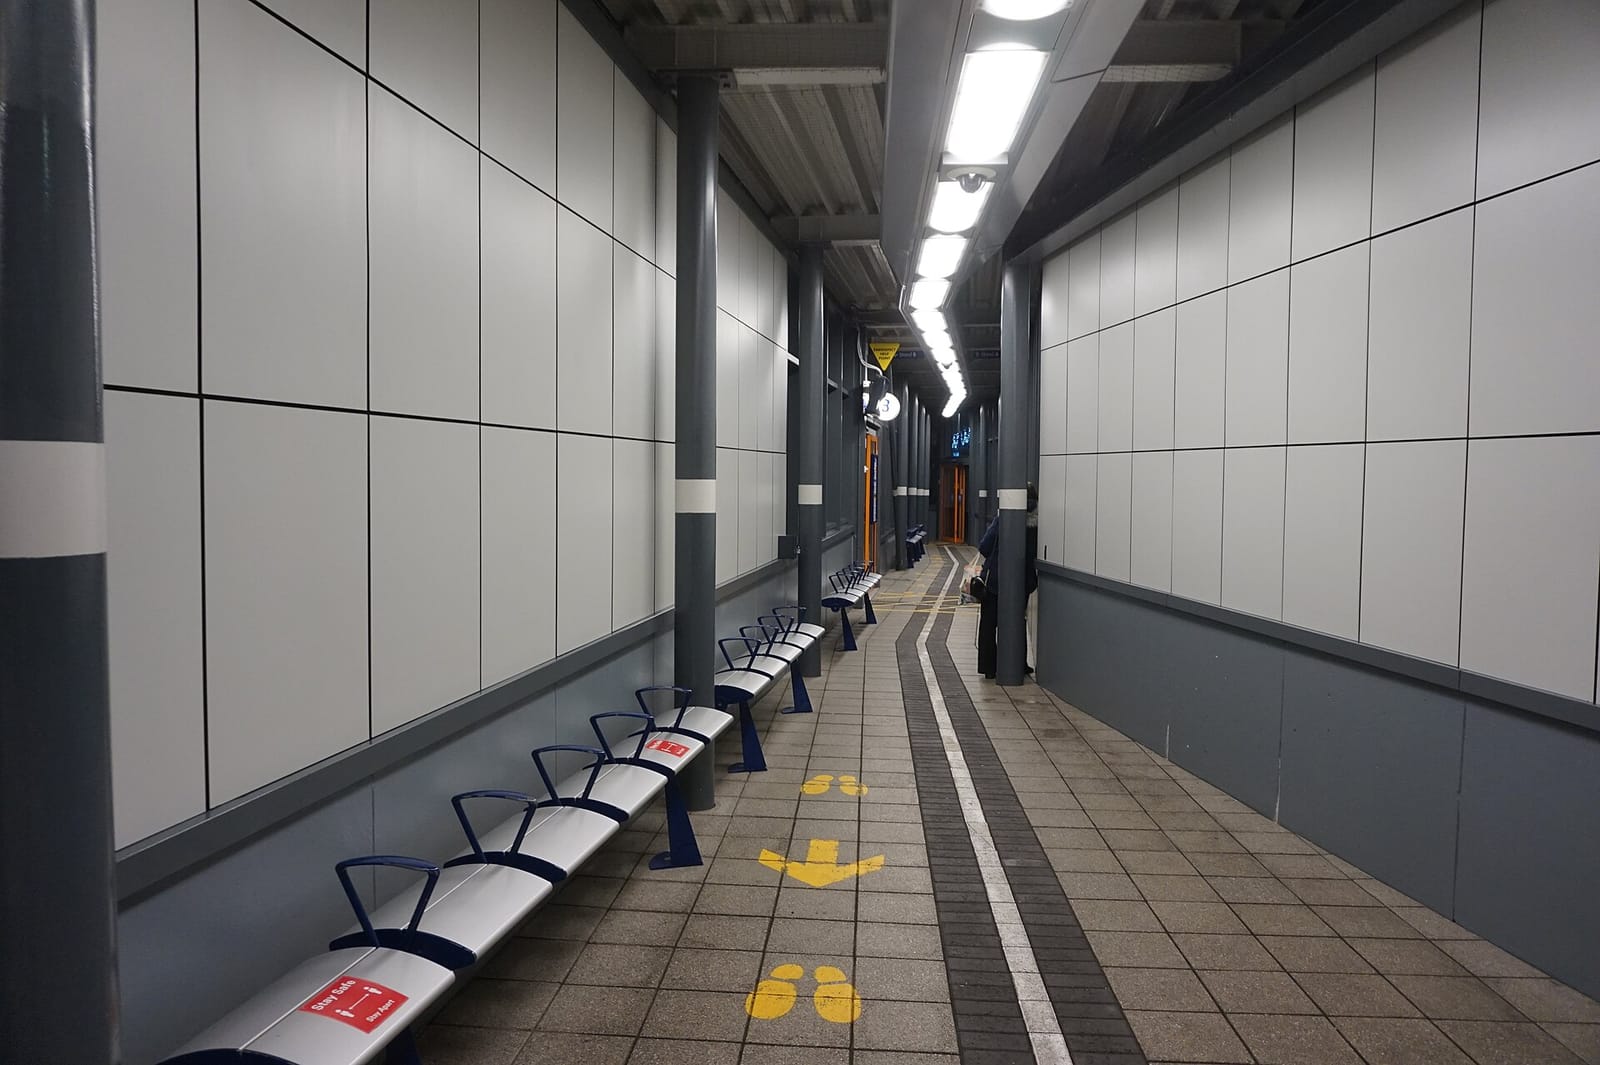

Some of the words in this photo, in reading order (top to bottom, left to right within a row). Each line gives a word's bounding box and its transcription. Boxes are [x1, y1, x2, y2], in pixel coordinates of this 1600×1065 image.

[881, 399, 890, 413] 3
[311, 994, 338, 1011] Stay
[331, 980, 357, 995] Safe
[366, 1011, 382, 1023] Stay
[379, 999, 396, 1012] Apart
